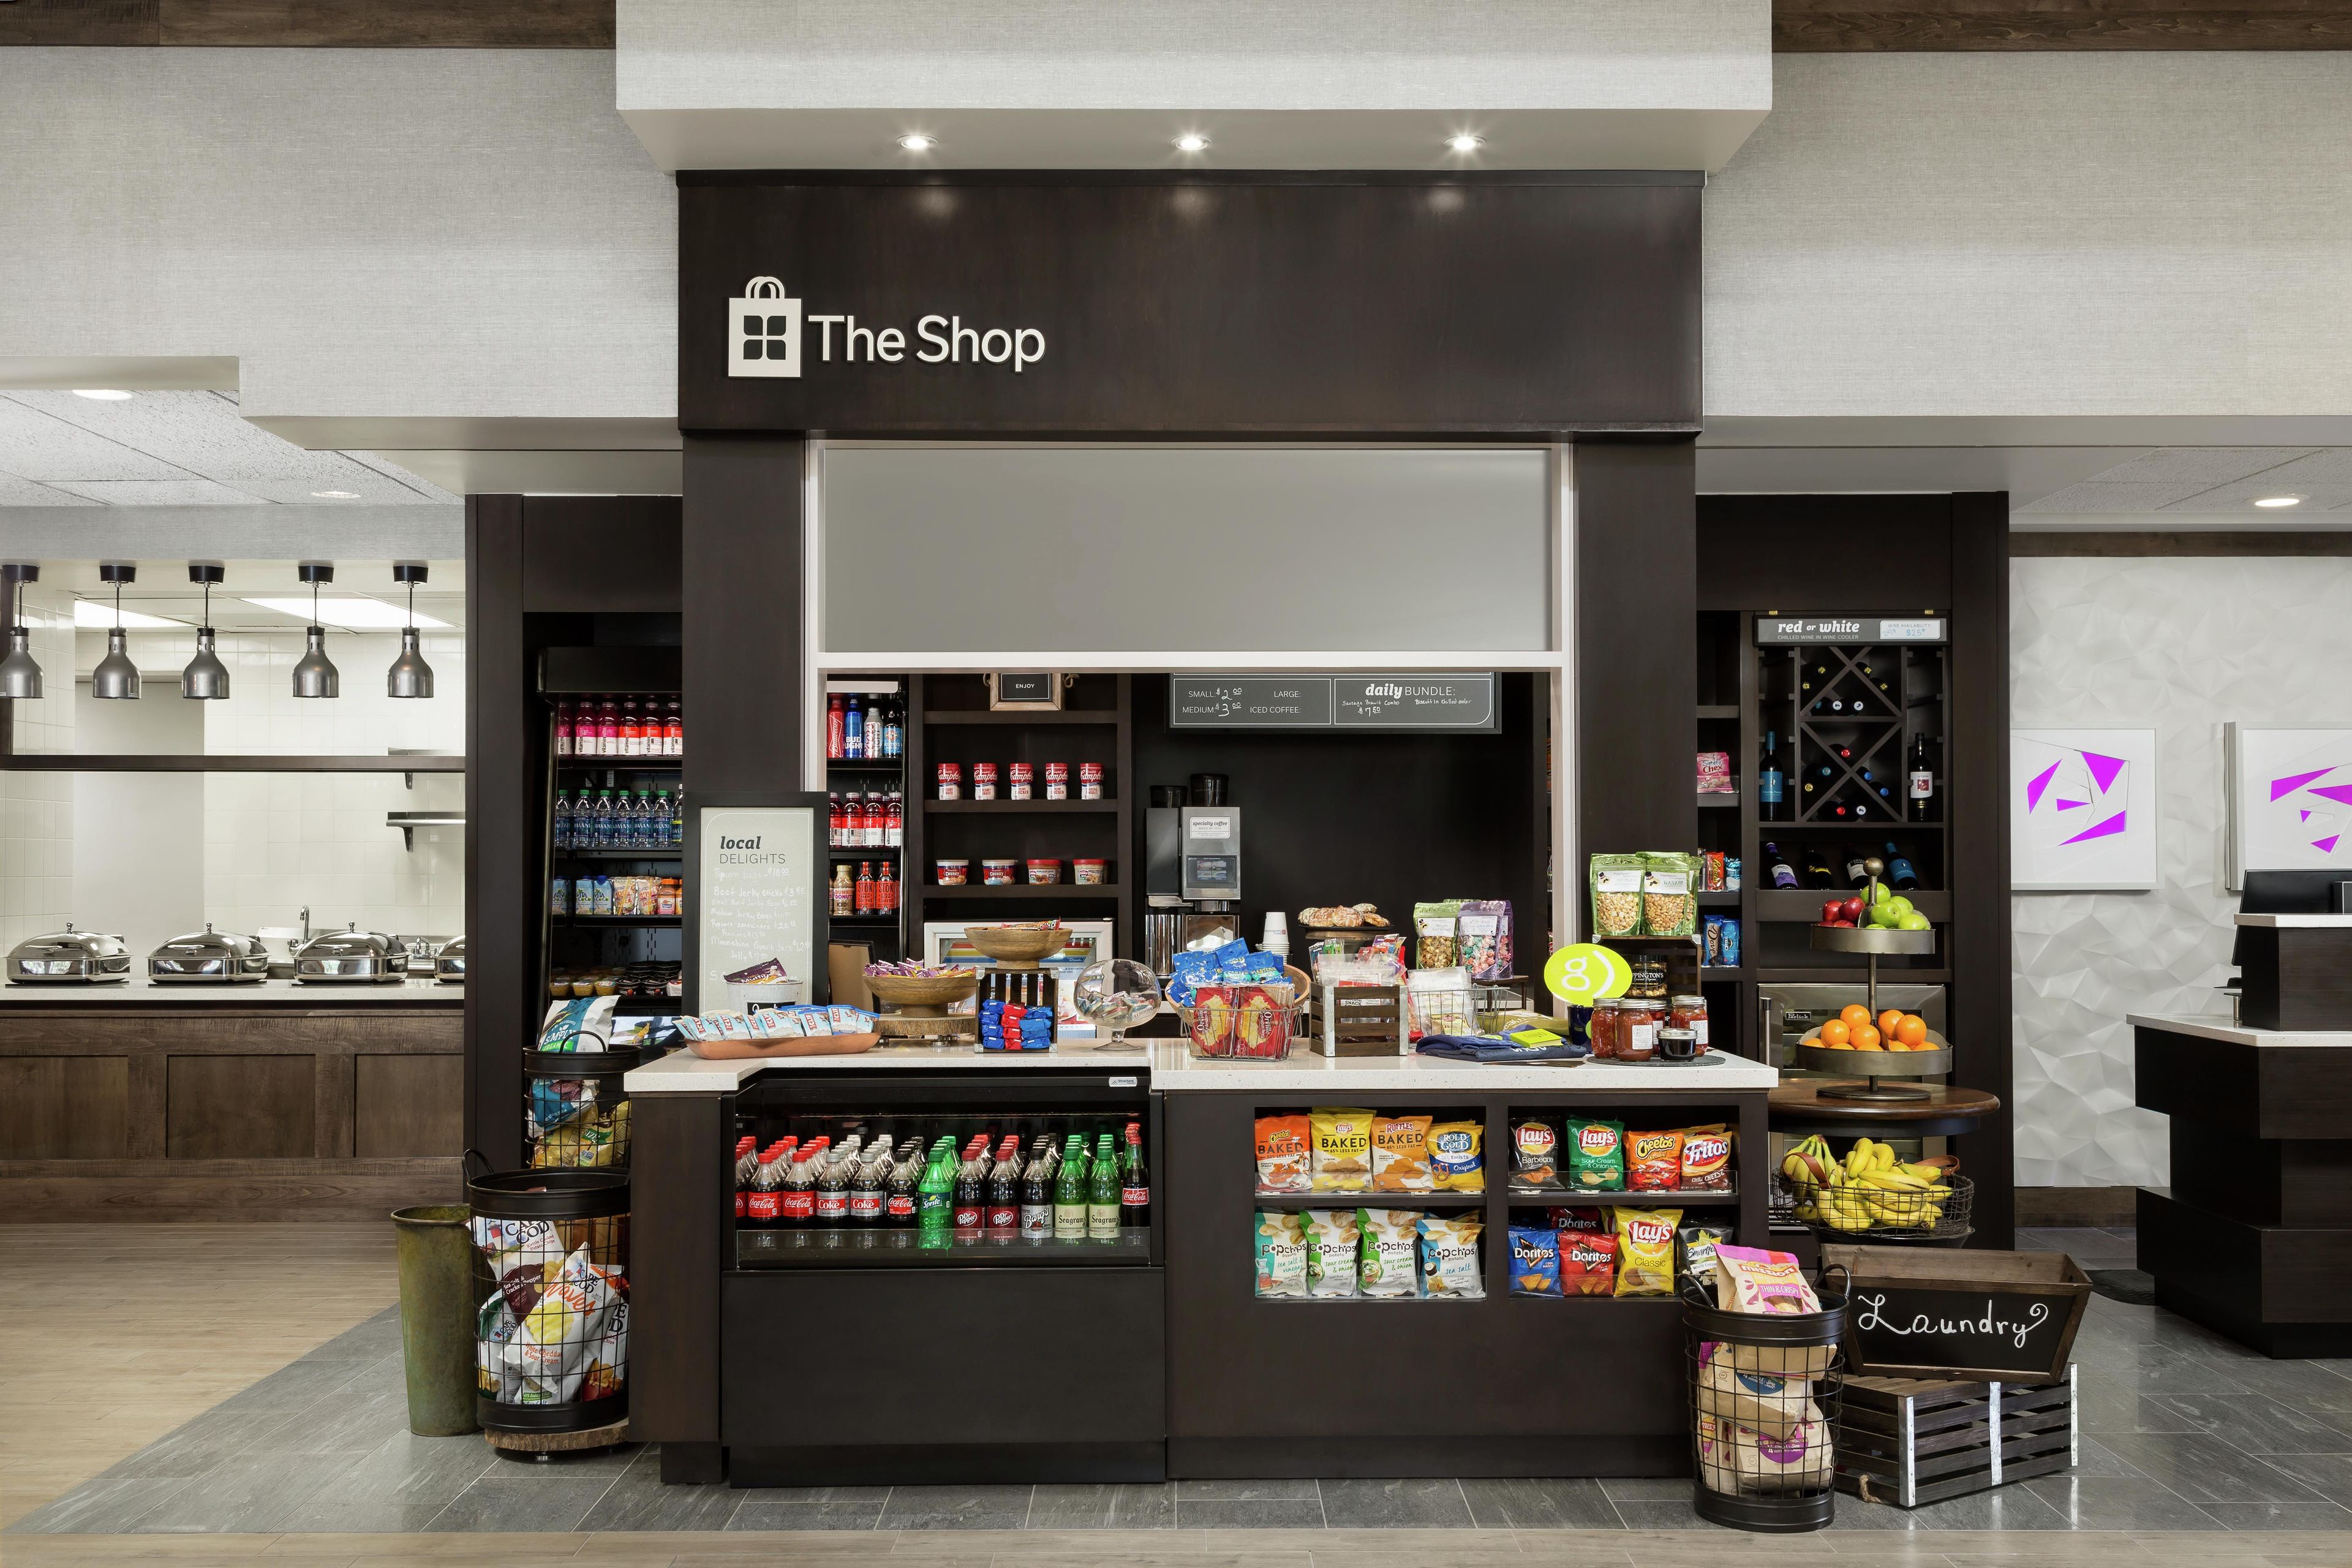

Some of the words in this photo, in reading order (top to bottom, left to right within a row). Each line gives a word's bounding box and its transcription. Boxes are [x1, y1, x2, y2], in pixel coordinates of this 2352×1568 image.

[808, 315, 905, 362] The
[916, 314, 1046, 372] Shop
[1777, 620, 1803, 633] red
[1819, 620, 1860, 633] white
[1365, 683, 1403, 699] daily
[1404, 687, 1456, 696] BUNDLE:
[720, 835, 761, 850] local
[719, 854, 786, 864] DELIGHTS
[714, 867, 740, 882] Popcorn
[714, 886, 736, 896] Beef
[710, 936, 750, 948] Moonshine
[1708, 923, 1719, 956] Dove
[730, 950, 747, 962] Jelly
[1134, 1006, 1153, 1018] ALTOIDS
[1336, 1123, 1353, 1134] Lay's
[1386, 1123, 1414, 1133] RUFFLES
[1269, 1131, 1291, 1144] Cheetos
[1378, 1134, 1423, 1145] BAKED
[1520, 1127, 1551, 1145] Lay's
[1582, 1129, 1616, 1147] Lay's
[1258, 1143, 1303, 1155] BAKED
[1322, 1138, 1366, 1148] BAKED
[1441, 1141, 1469, 1150] GOLD
[1637, 1137, 1675, 1156] Cheetos
[1684, 1139, 1728, 1163] Fritos
[1453, 1161, 1476, 1172] Original
[1704, 1170, 1725, 1182] CHEESE
[1124, 1191, 1147, 1201] Coca-Cola
[749, 1197, 777, 1208] Coca-Cola
[785, 1197, 812, 1208] Coca-Cola
[818, 1199, 840, 1210] Coke
[853, 1199, 875, 1209] Coke
[888, 1197, 914, 1208] Coca-Cola
[923, 1199, 942, 1209] Sprite
[957, 1214, 976, 1225] Pepper
[993, 1214, 1012, 1225] Pepper
[1023, 1207, 1049, 1229] Barq's
[1058, 1215, 1087, 1226] Seagram's
[1091, 1215, 1120, 1226] Seagram's
[1558, 1218, 1597, 1228] Doritos
[1632, 1221, 1673, 1244] Lay's
[1262, 1243, 1306, 1256] popchips
[1309, 1243, 1355, 1256] popchips
[1368, 1241, 1414, 1253] popchips
[1514, 1247, 1554, 1259] Doritos
[1428, 1247, 1475, 1260] popchips
[1572, 1250, 1612, 1262] Doritos
[1458, 1263, 1471, 1272] salt
[1634, 1257, 1666, 1268] Classic
[1283, 1265, 1303, 1274] vinegar
[544, 1272, 597, 1316] Waves
[1781, 1286, 1800, 1296] CRISPY
[499, 1319, 512, 1333] CAPE
[1858, 1294, 2049, 1349] Laundry
